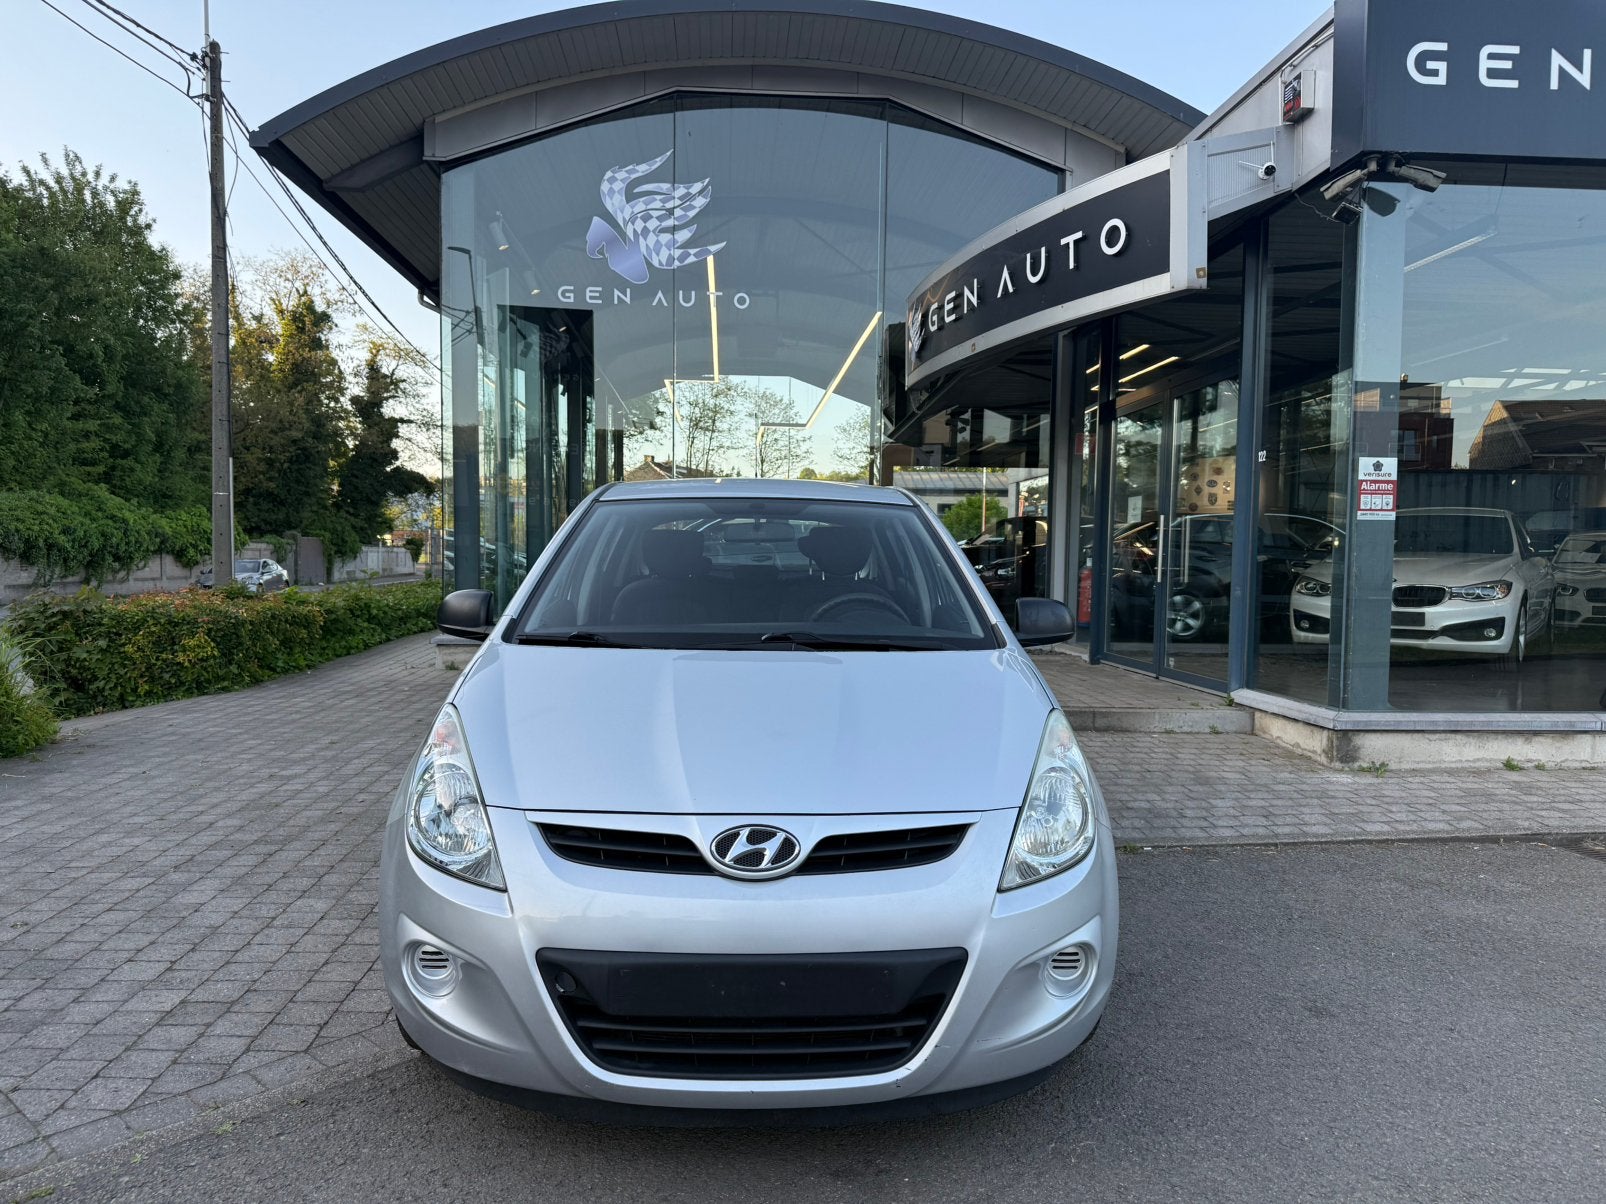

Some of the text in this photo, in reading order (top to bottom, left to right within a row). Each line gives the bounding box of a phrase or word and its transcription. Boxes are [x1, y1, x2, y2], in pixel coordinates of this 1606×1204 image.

[1406, 41, 1592, 91] GEN
[927, 217, 1128, 333] GEN AUTO
[557, 285, 750, 310] GEN AUTO
[1361, 481, 1394, 490] Alarme
